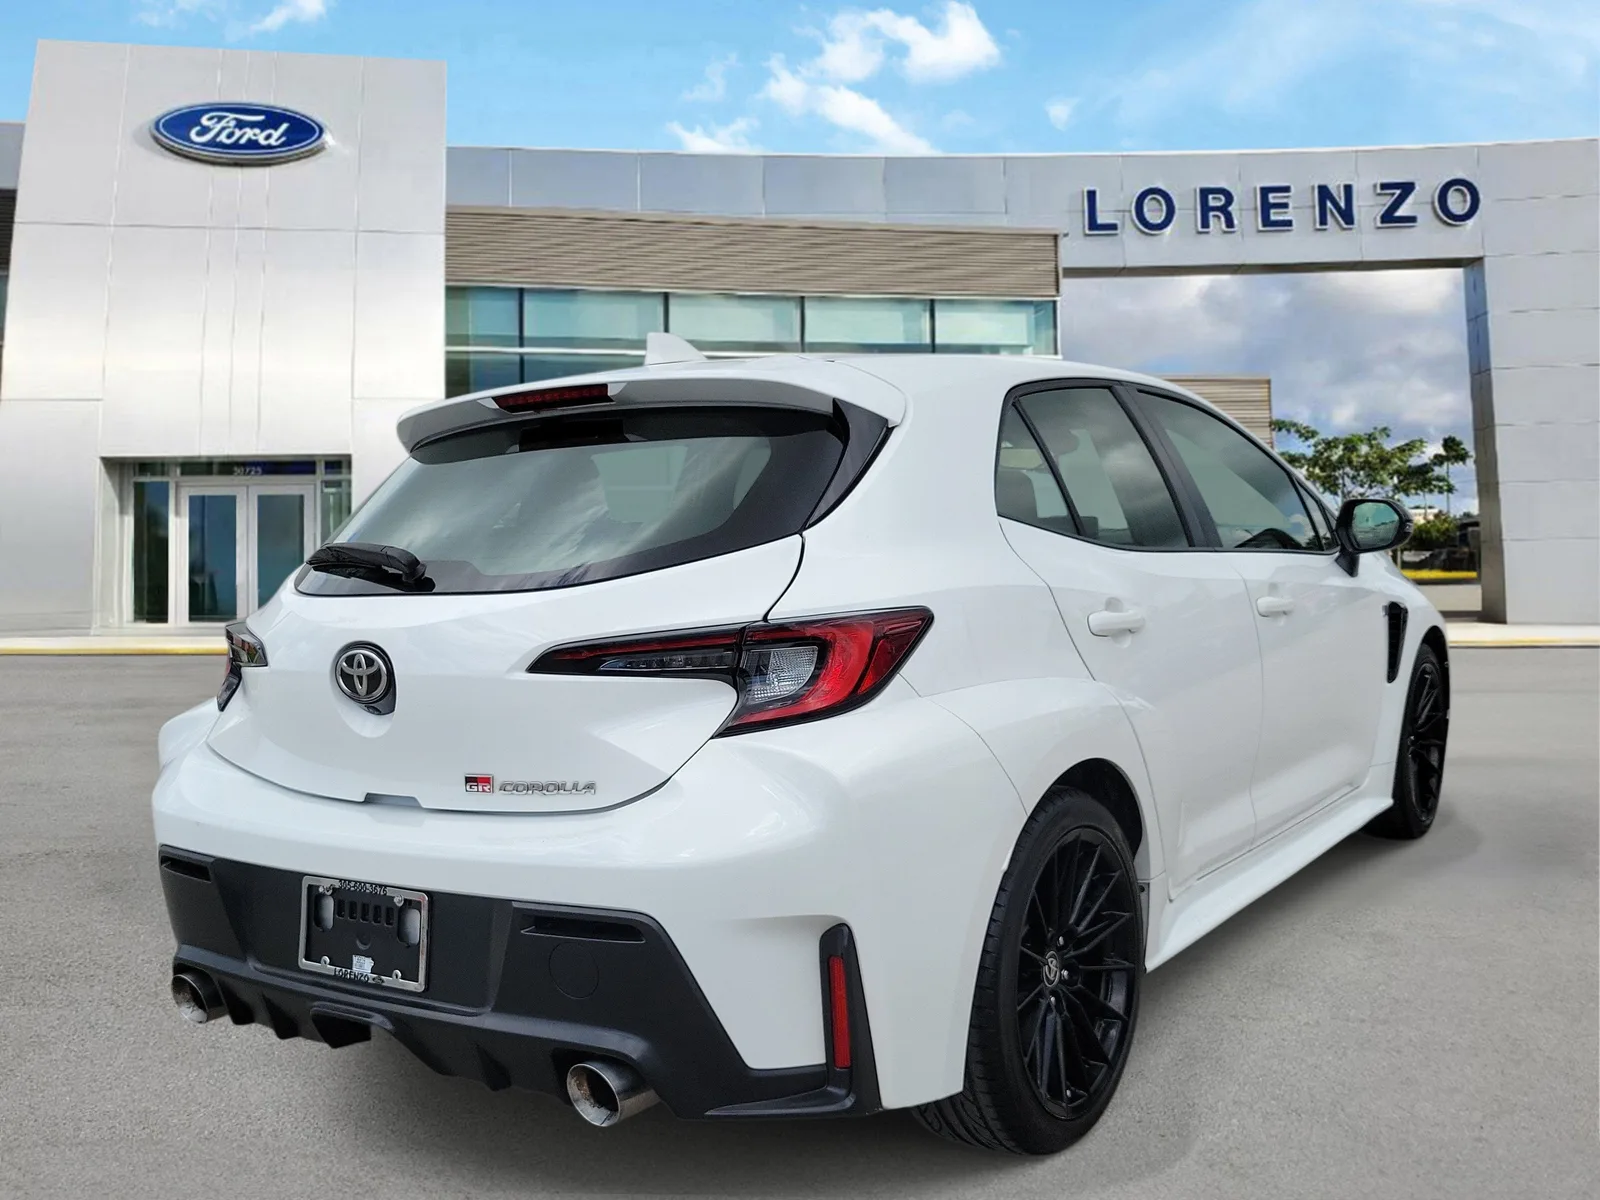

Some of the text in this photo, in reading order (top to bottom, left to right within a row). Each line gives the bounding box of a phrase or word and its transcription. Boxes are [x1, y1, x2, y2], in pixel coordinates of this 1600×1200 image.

[190, 111, 290, 146] Ford
[1084, 178, 1481, 234] LORENZO
[466, 781, 596, 795] GR COROLLA
[333, 967, 370, 983] LORENZO
